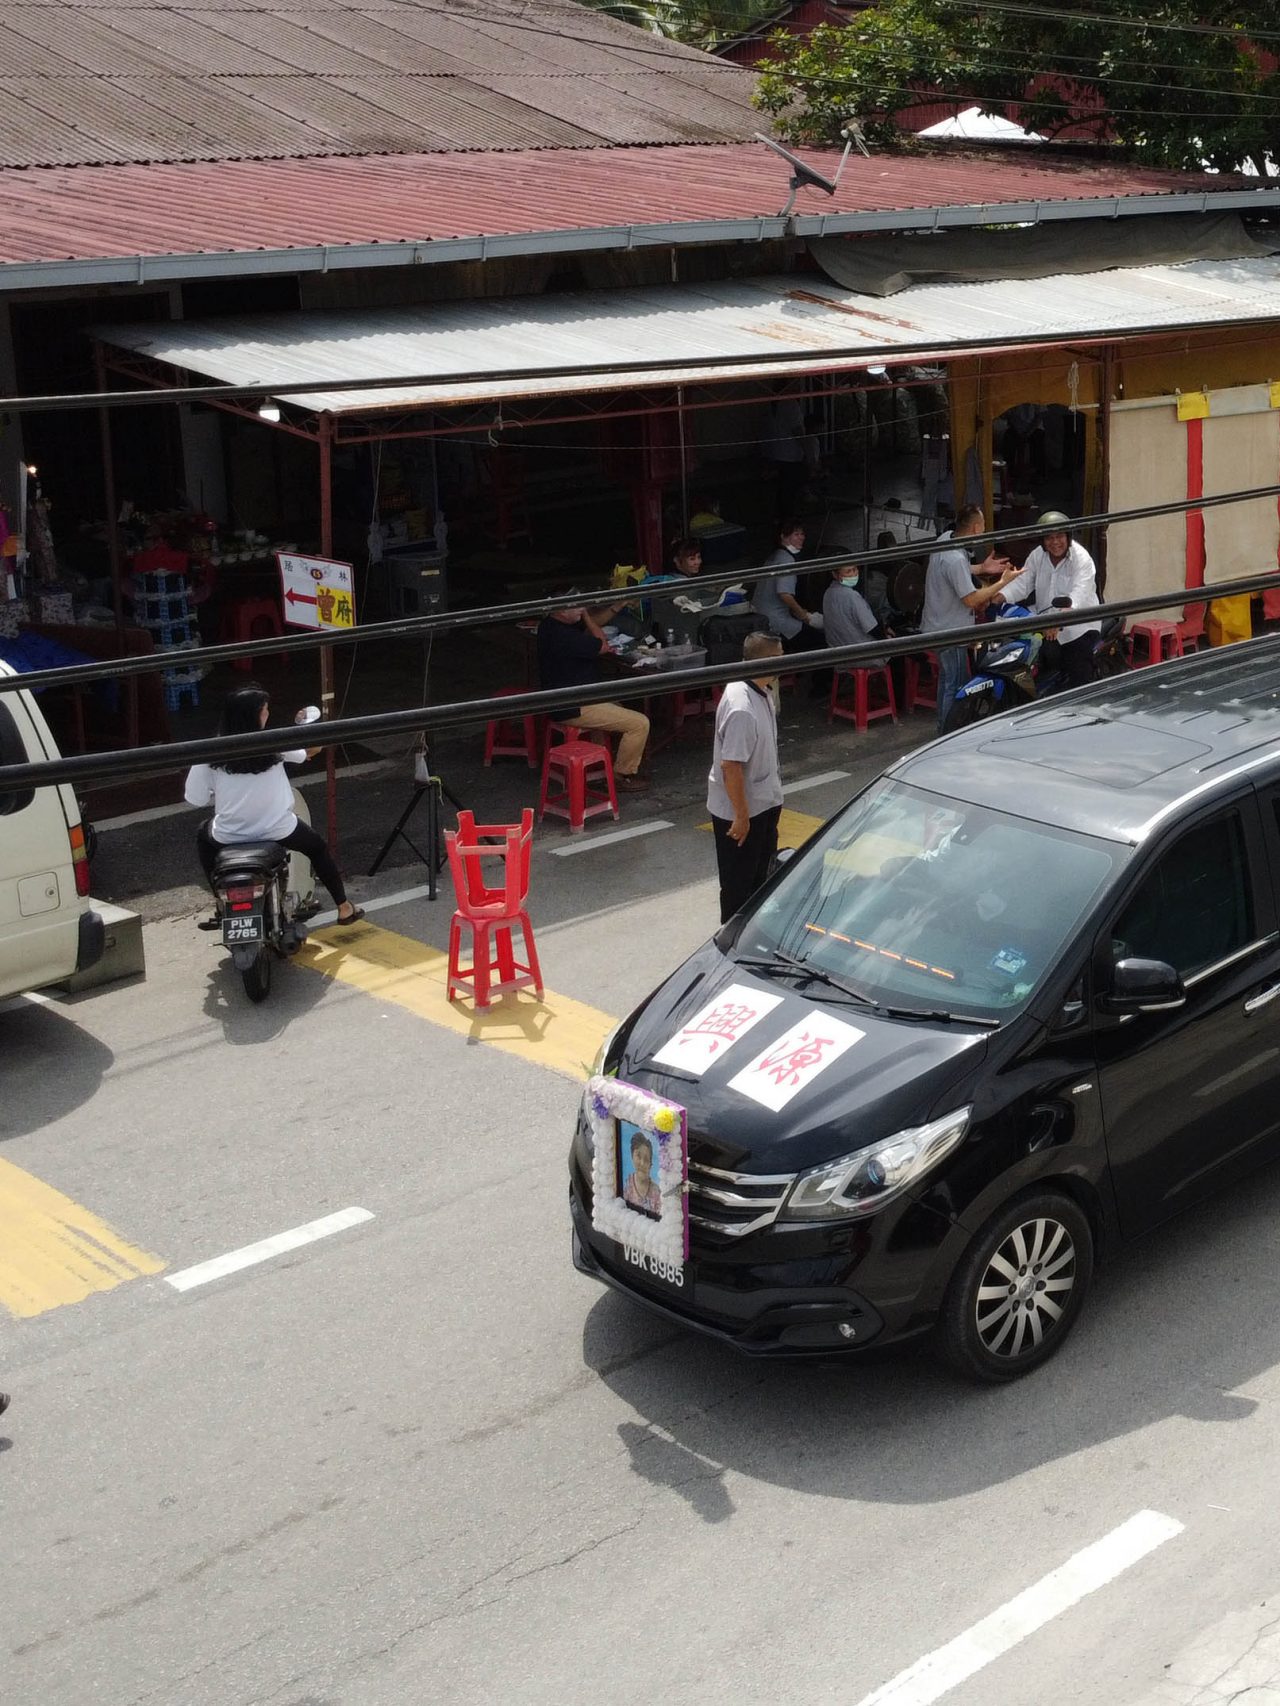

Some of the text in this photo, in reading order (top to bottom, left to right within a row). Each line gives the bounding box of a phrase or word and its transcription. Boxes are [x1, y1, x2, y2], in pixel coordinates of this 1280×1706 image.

[227, 928, 258, 939] 2765
[231, 918, 254, 929] PLW
[752, 1032, 835, 1085] 源
[623, 1244, 684, 1287] VBK 8985
